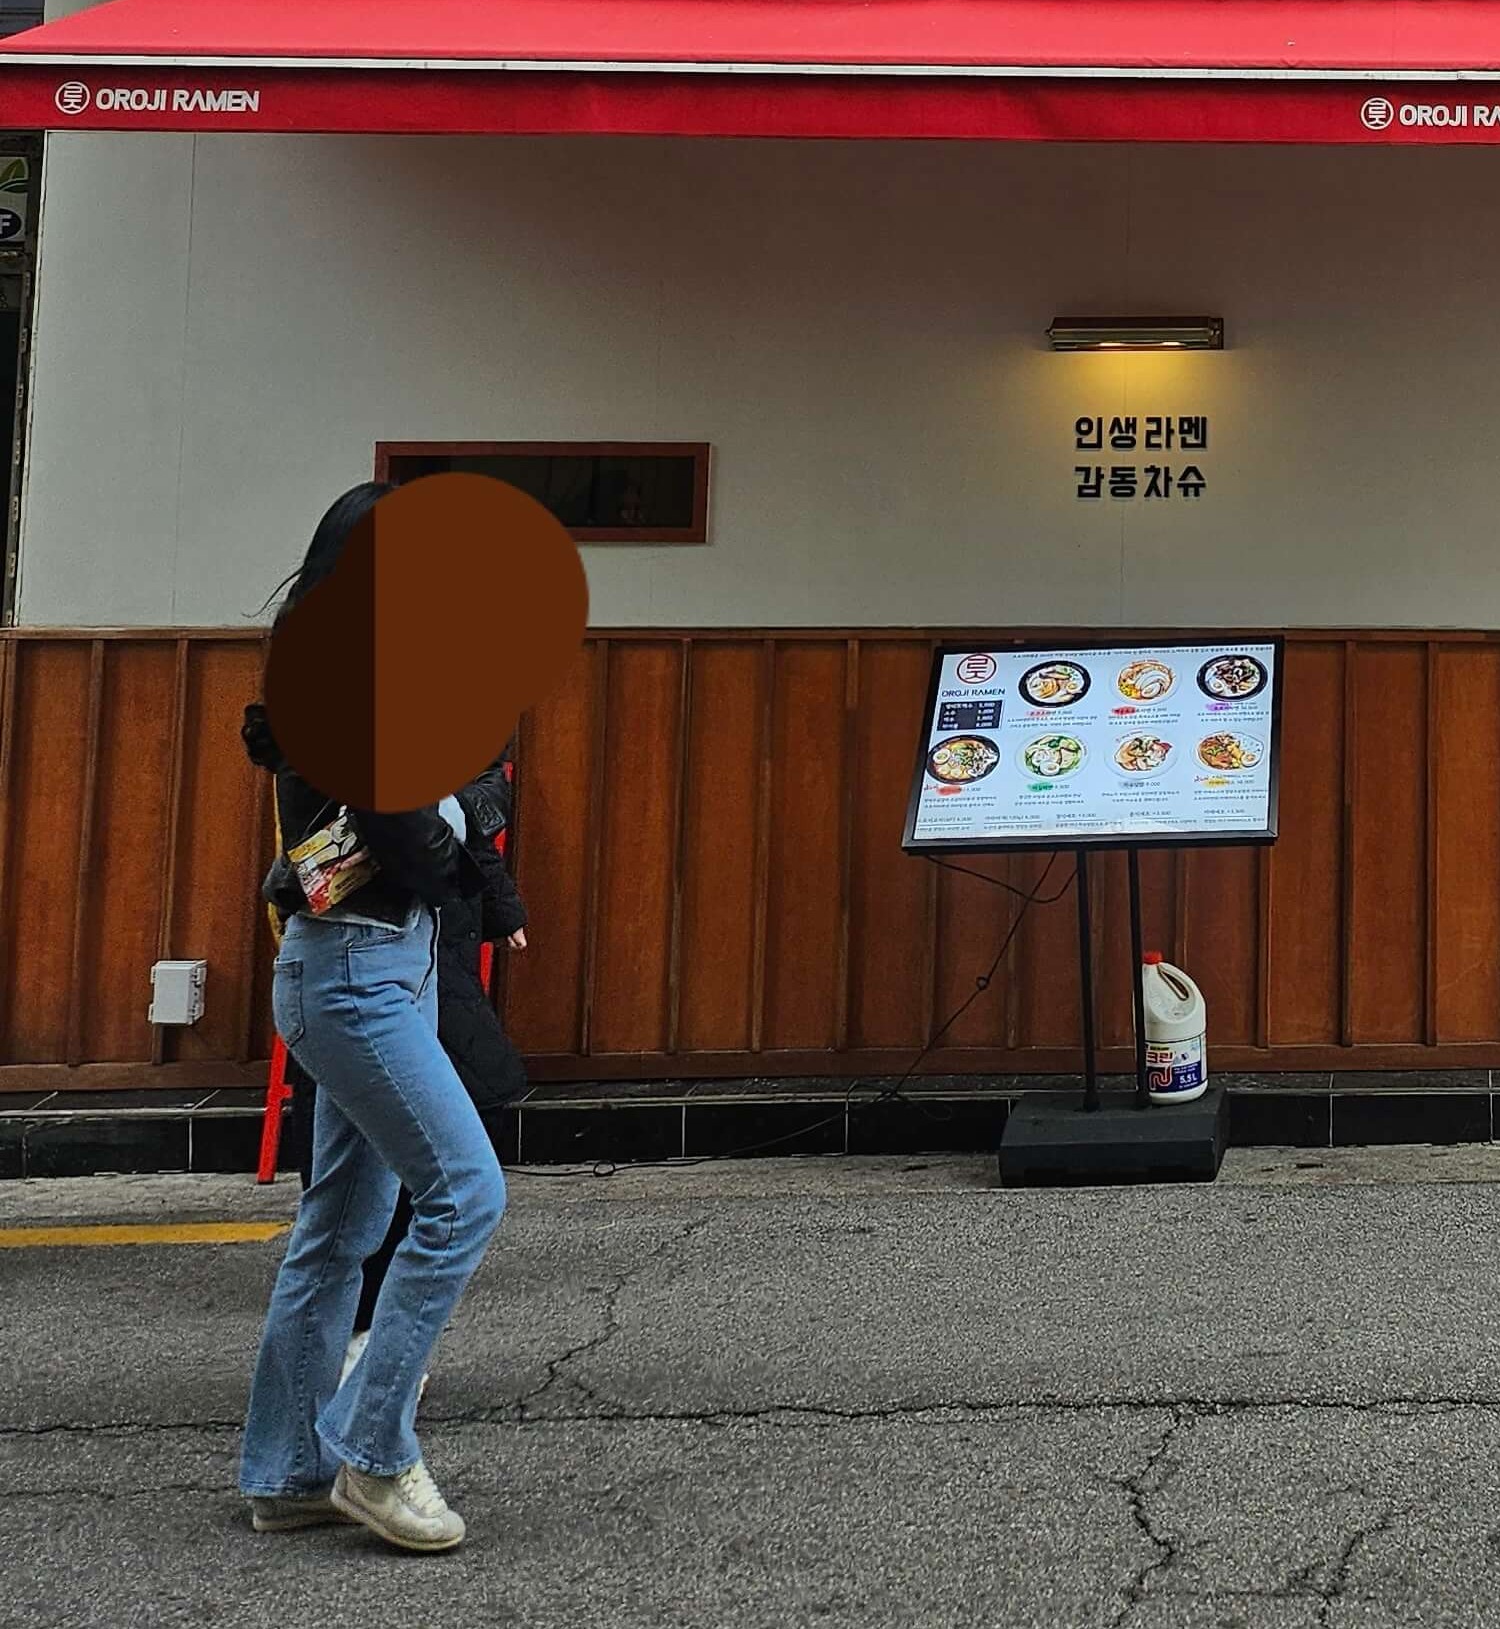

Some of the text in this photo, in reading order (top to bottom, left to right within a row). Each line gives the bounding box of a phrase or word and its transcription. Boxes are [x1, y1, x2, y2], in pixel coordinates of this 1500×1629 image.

[95, 88, 260, 113] OROJI RAMEN
[1399, 104, 1468, 127] OROJI
[1074, 416, 1208, 449] 인생라멘
[1074, 464, 1207, 498] 감동차슈
[941, 687, 1006, 698] OROJI RAMEN
